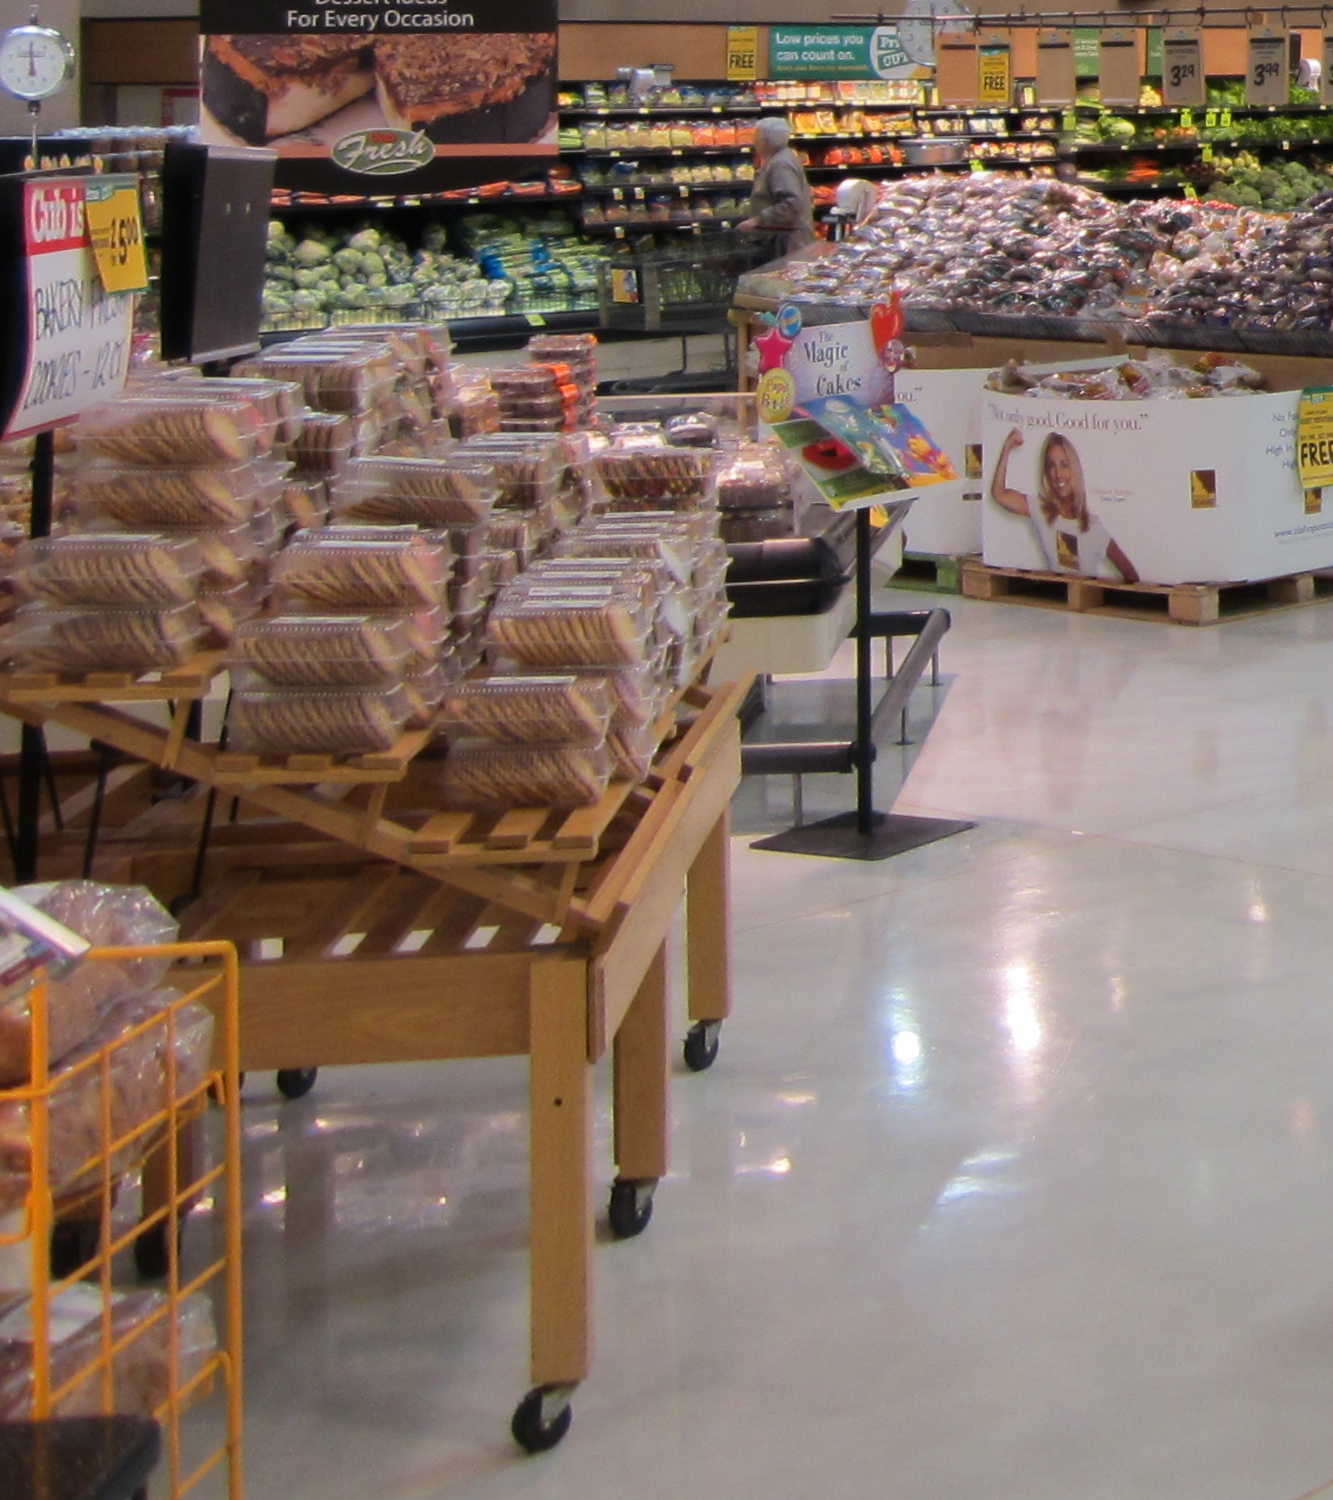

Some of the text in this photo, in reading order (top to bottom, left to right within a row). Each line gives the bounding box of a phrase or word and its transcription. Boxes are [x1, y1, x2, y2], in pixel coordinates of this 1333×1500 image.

[287, 10, 475, 31] For Every Occasion
[776, 32, 864, 48] Low prices you
[879, 37, 901, 49] Pri
[729, 54, 755, 69] FREE
[776, 49, 855, 61] can count on.
[983, 75, 1005, 91] FREE
[338, 128, 429, 169] Fresh
[32, 187, 68, 243] Cub
[803, 341, 849, 368] Magic
[816, 373, 862, 397] Cakes
[1056, 411, 1089, 429] Good
[1092, 413, 1110, 430] for
